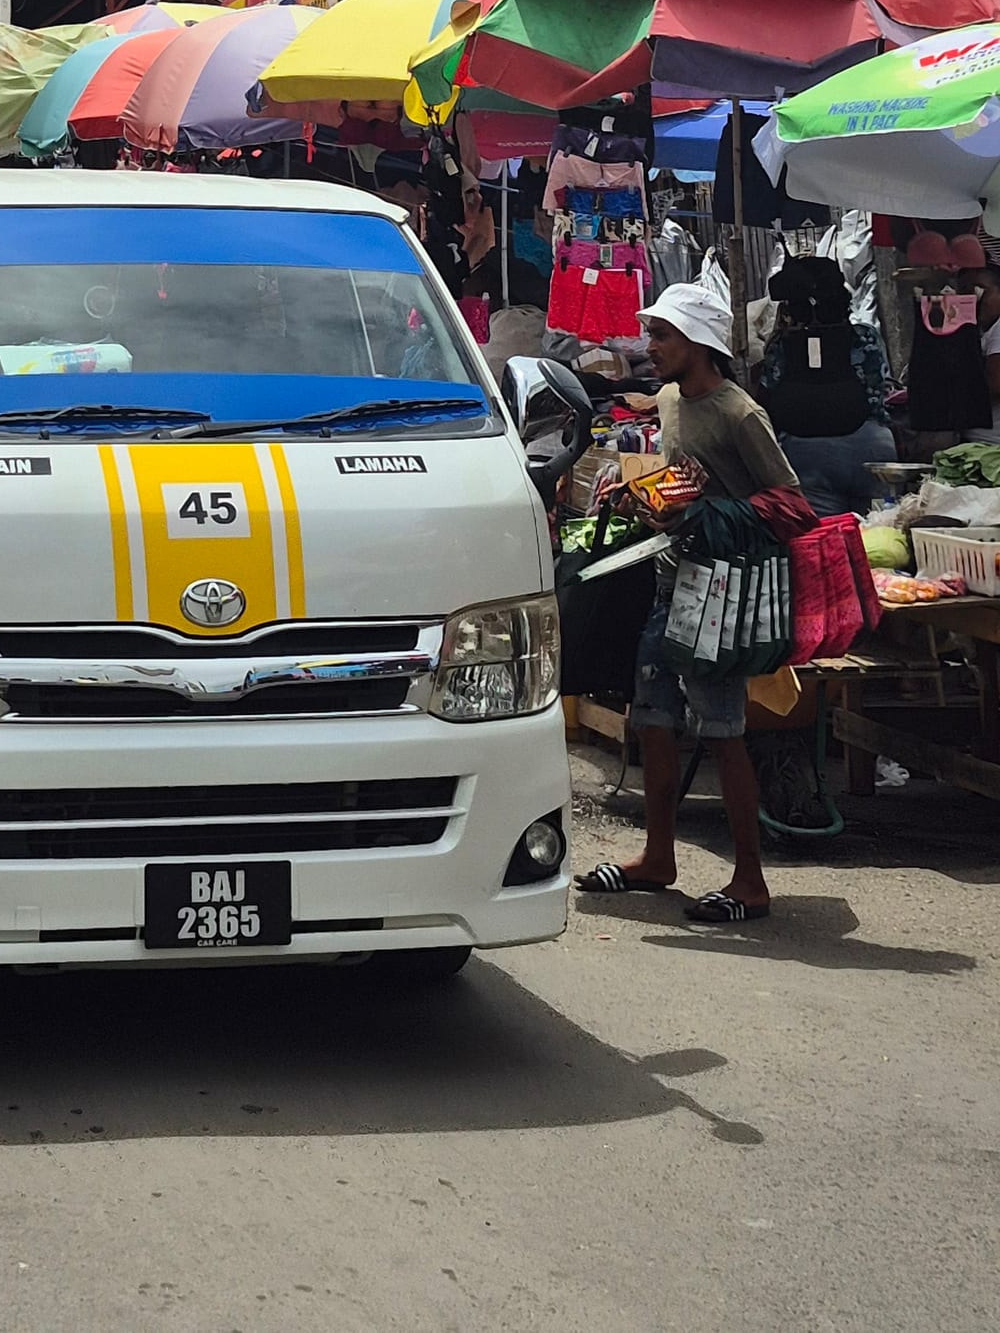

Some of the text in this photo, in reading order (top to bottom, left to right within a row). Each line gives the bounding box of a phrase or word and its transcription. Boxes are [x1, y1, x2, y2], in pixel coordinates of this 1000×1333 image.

[827, 96, 930, 115] WASHING MACHINE
[846, 116, 857, 132] IN
[870, 115, 900, 130] PACK
[341, 456, 423, 473] LAMAHA
[178, 491, 238, 525] 45
[191, 869, 246, 903] BAJ
[177, 904, 260, 939] 2365
[197, 938, 238, 947] CAR CARE
